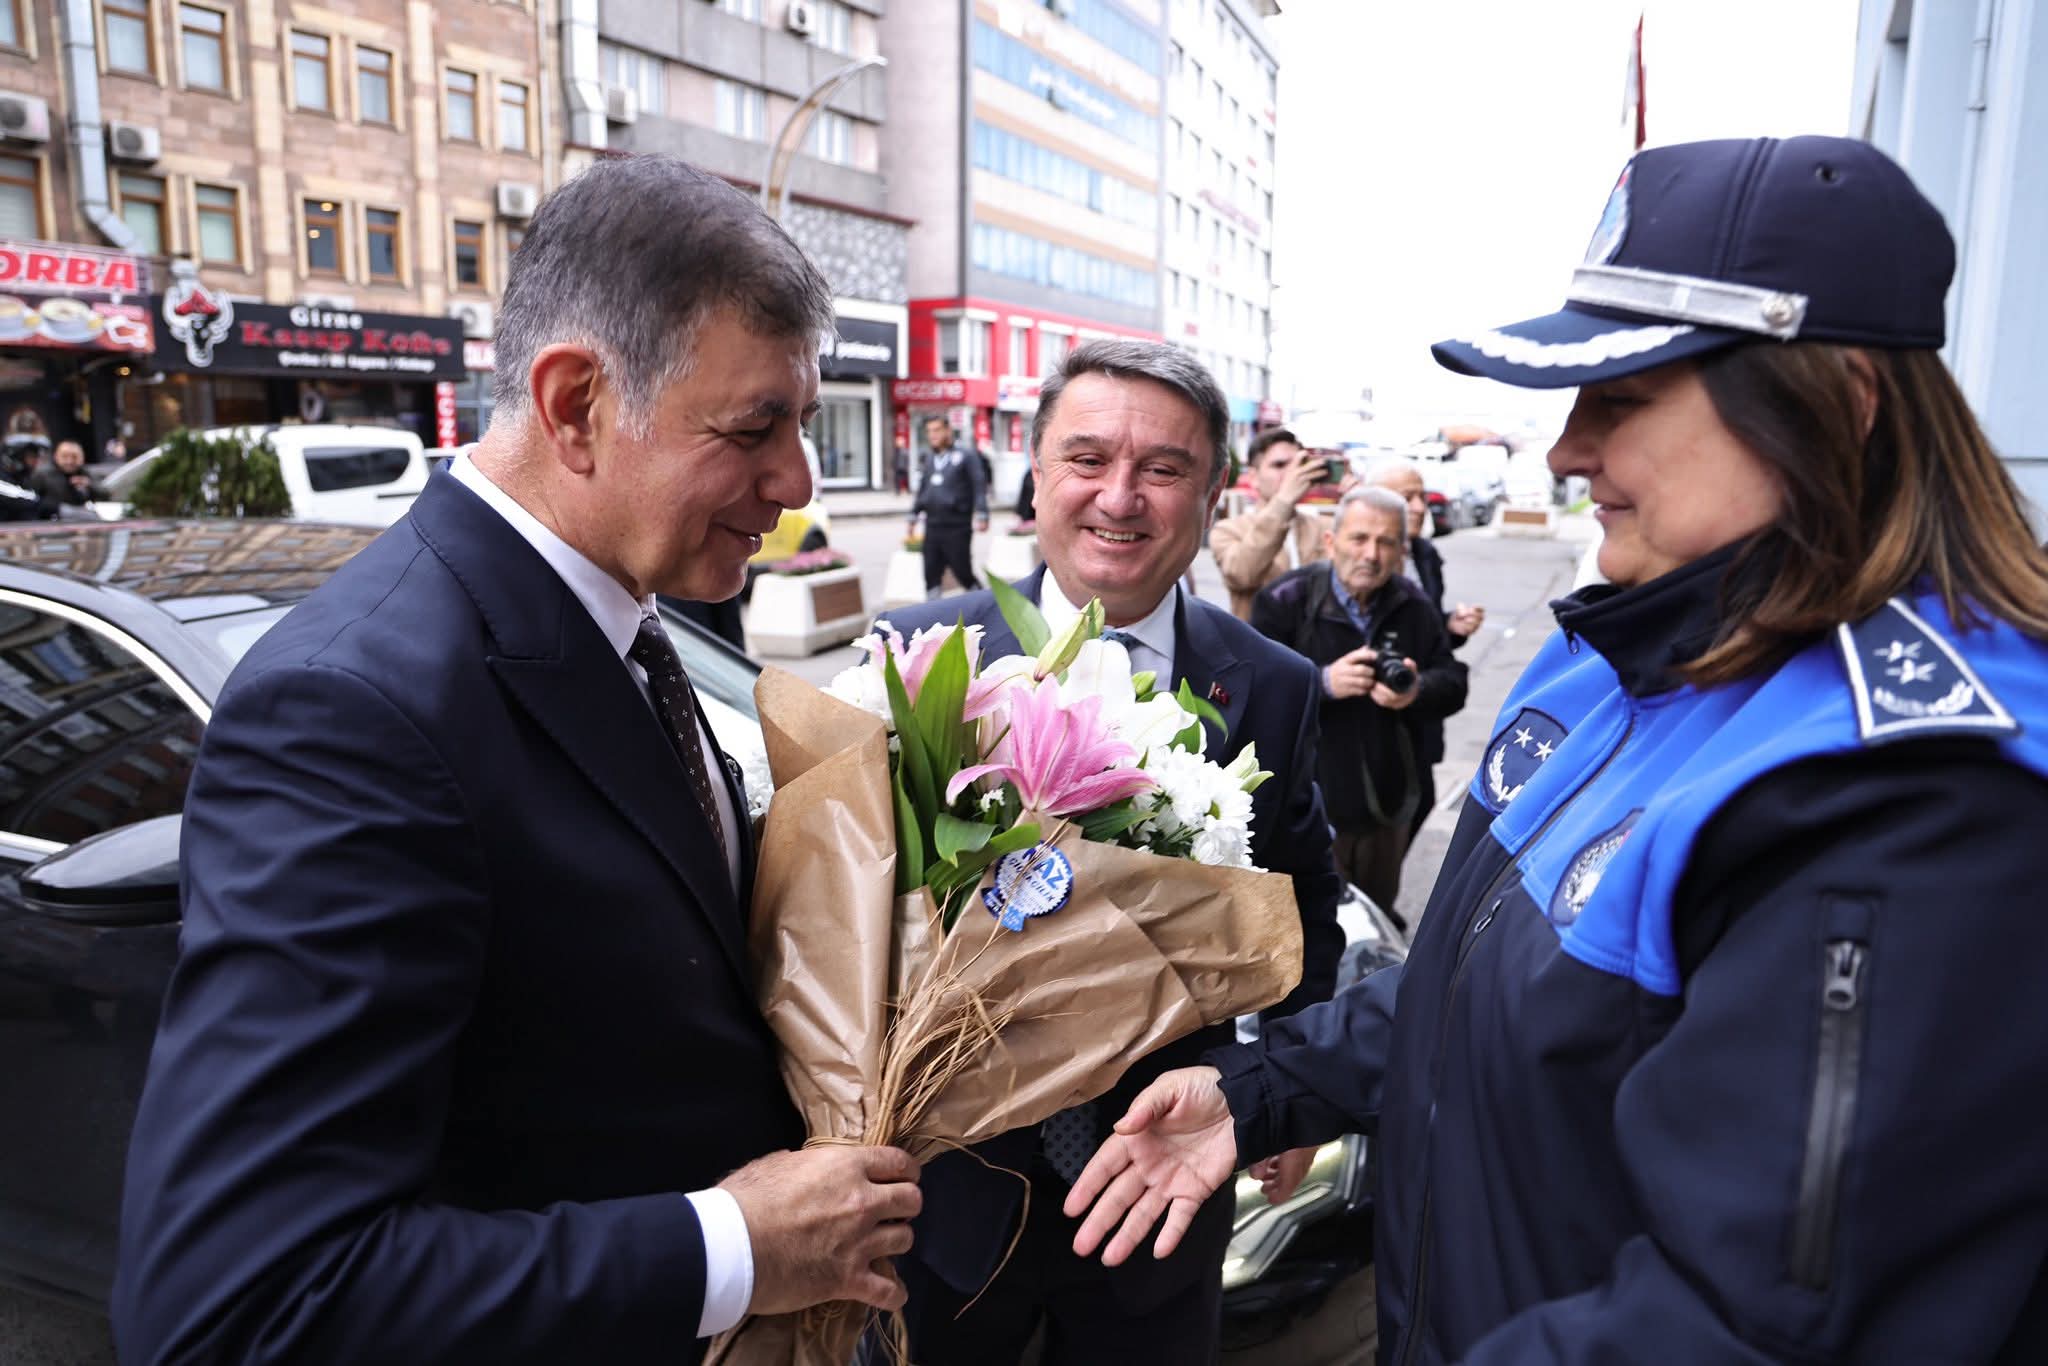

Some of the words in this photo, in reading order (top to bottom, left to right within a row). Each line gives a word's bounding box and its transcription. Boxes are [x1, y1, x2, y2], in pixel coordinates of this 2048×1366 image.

[0, 251, 135, 289] ORBA
[289, 305, 363, 330] Girne
[240, 321, 354, 352] Kasap
